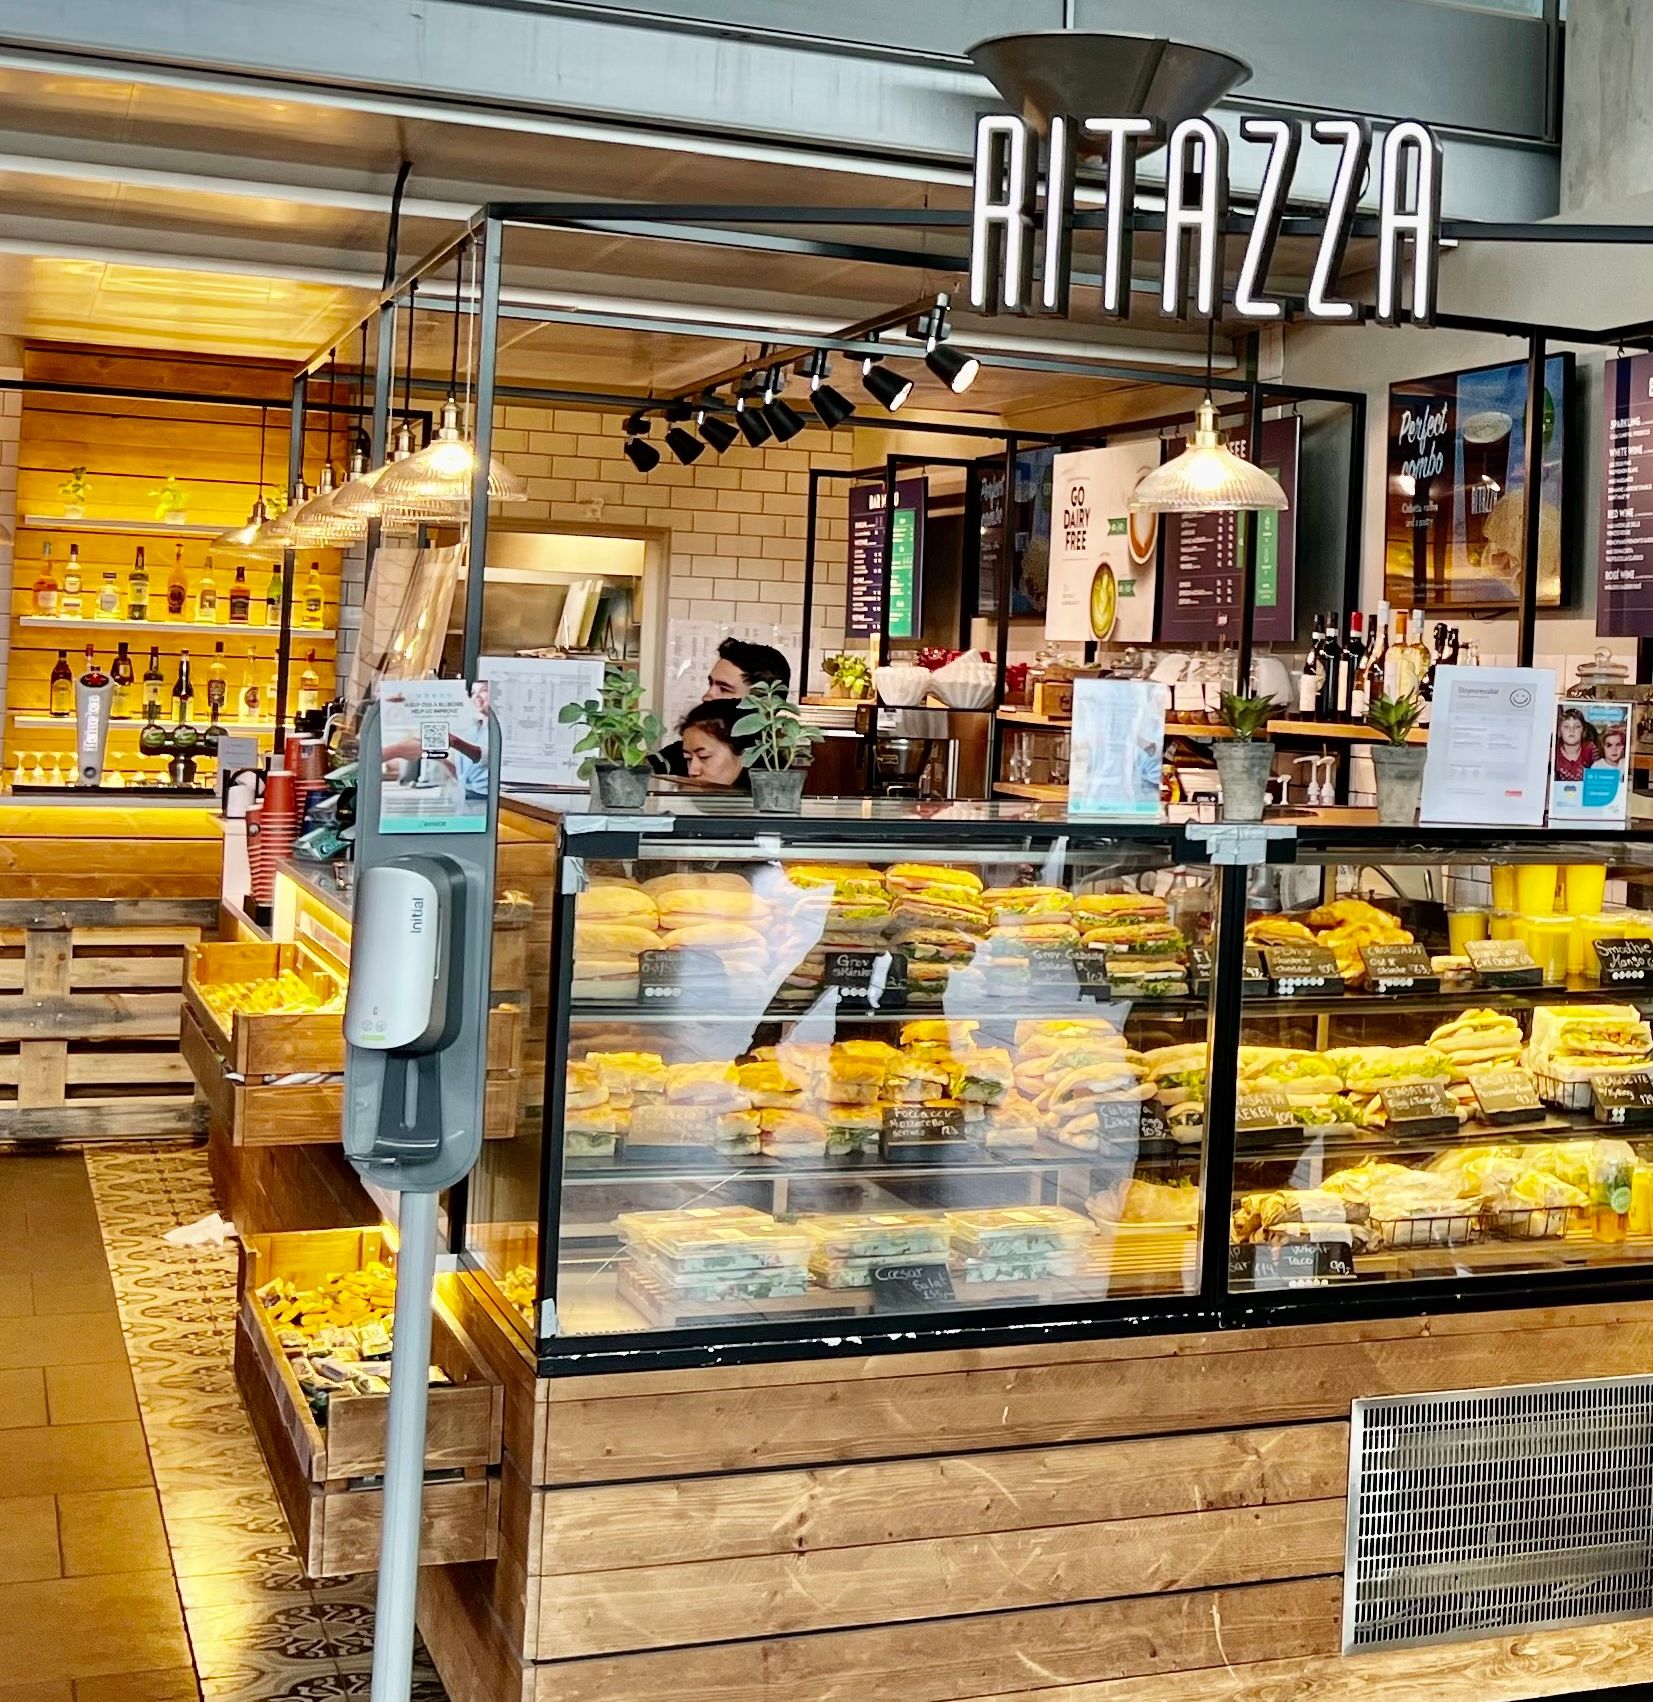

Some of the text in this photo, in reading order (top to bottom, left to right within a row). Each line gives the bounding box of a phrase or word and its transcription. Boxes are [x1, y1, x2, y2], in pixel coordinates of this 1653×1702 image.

[970, 114, 1440, 326] RITAZZA
[1399, 401, 1448, 455] Perfect
[1401, 440, 1444, 480] combo
[1609, 445, 1643, 457] WHITE WINE
[1070, 486, 1085, 507] GO
[1063, 508, 1090, 530] DAIRY
[1619, 507, 1635, 518] WINE
[1065, 530, 1087, 551] FREE
[411, 897, 424, 934] Initial
[1032, 949, 1061, 960] Grov
[1595, 939, 1652, 957] Smoothie
[837, 954, 871, 968] Grov
[1610, 952, 1645, 968] Mango
